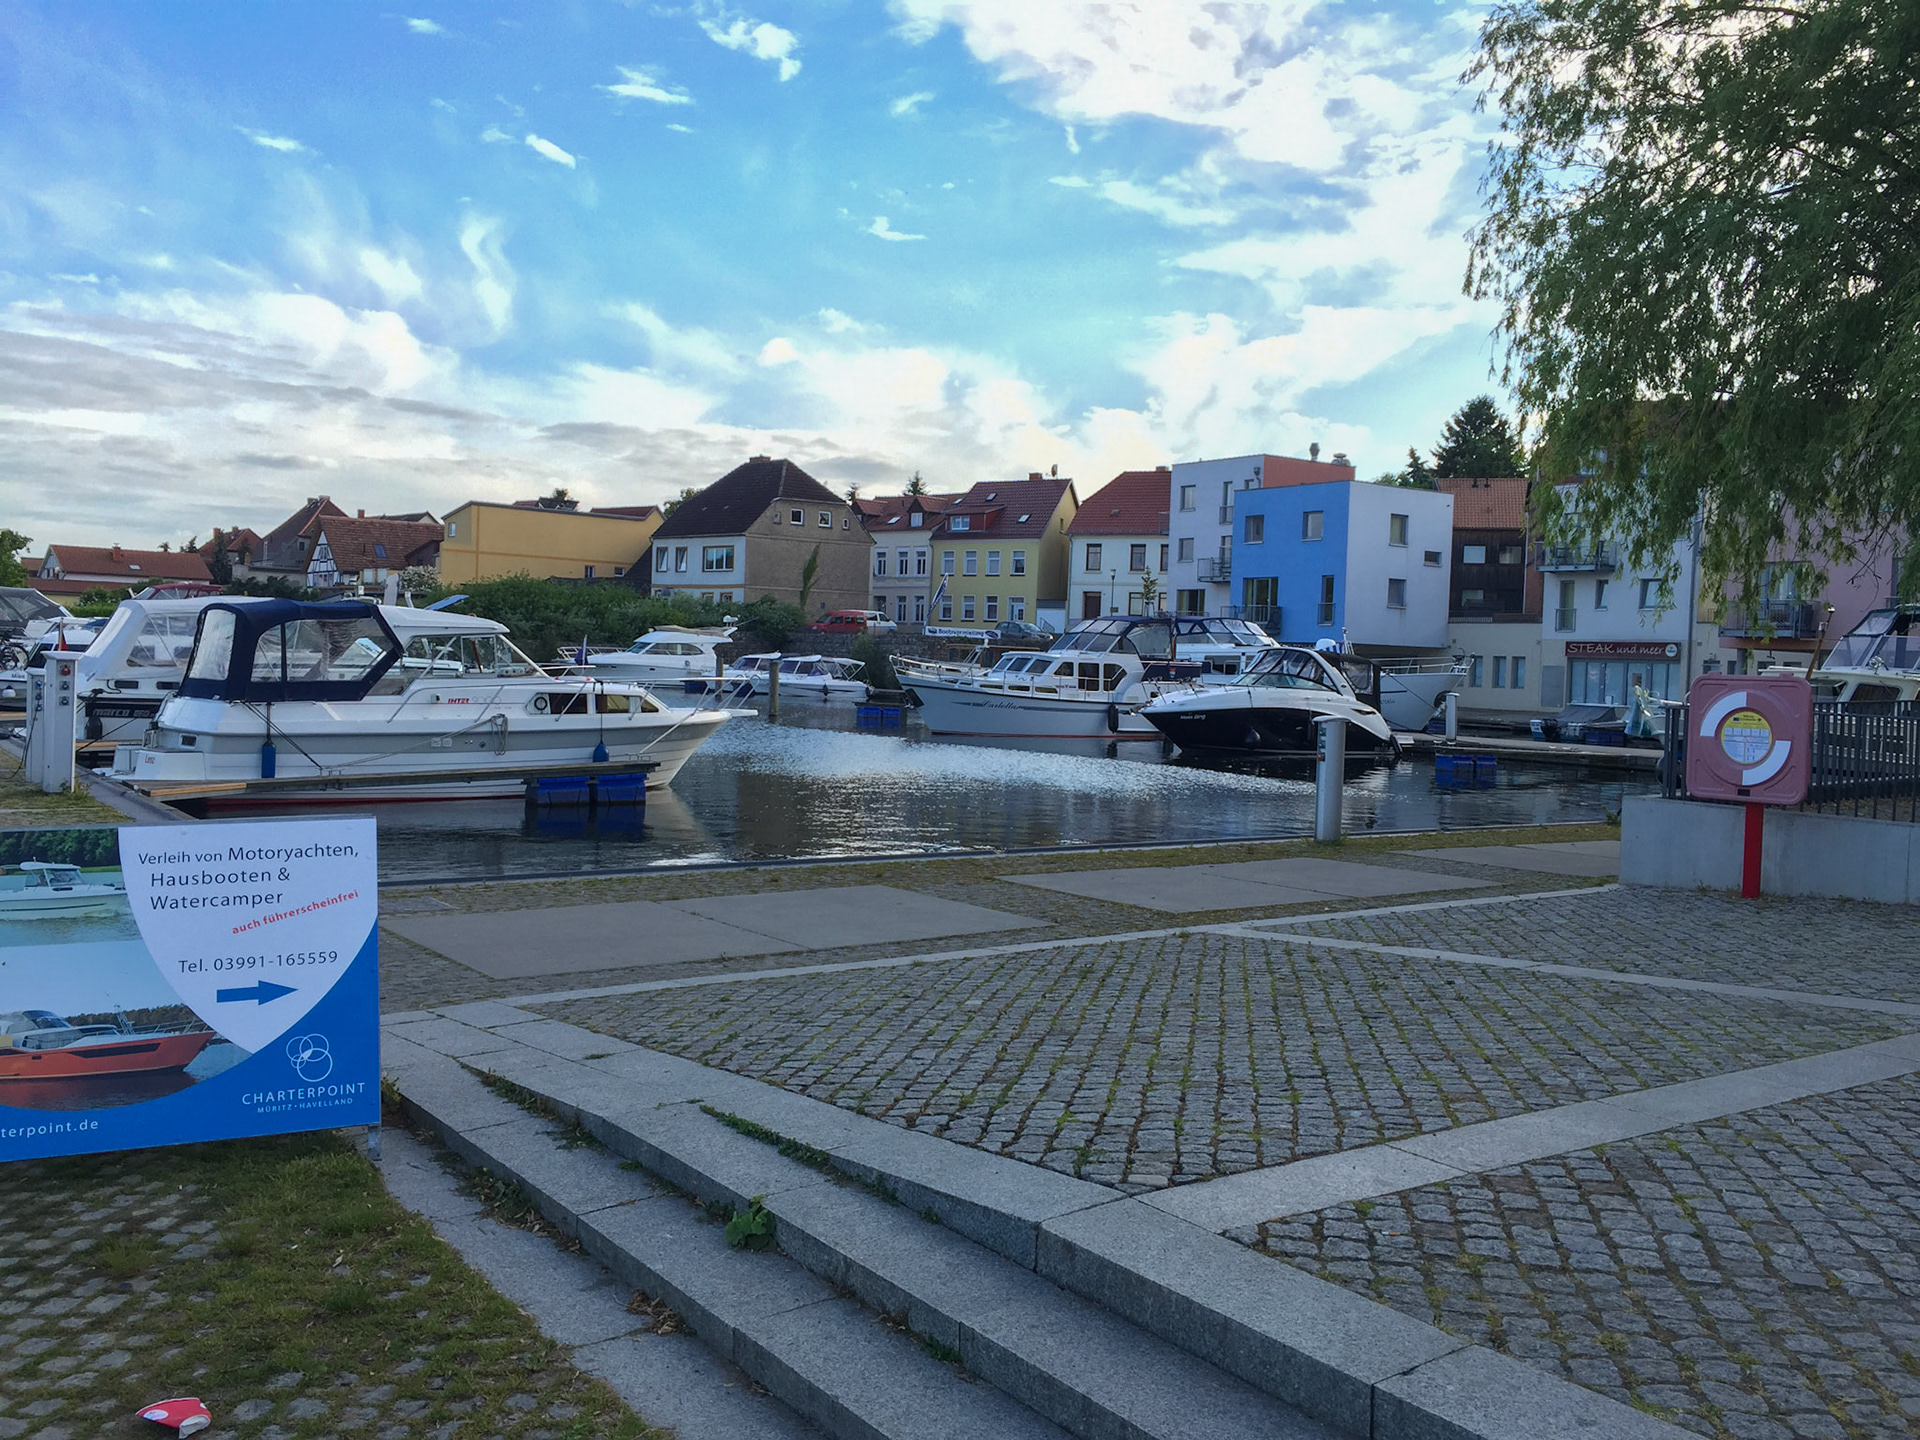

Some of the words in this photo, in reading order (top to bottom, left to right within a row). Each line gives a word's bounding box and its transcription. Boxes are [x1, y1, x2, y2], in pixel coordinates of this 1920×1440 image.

[1567, 643, 1615, 654] STEAK
[1616, 644, 1637, 654] und
[1639, 646, 1664, 655] meer
[138, 851, 191, 865] Verleih
[195, 852, 222, 863] von
[228, 843, 359, 863] Motoryachten,
[151, 870, 271, 887] Hausbooten
[277, 867, 290, 881] &
[150, 892, 283, 910] Watercamper
[232, 919, 261, 934] auch
[262, 889, 359, 925] führerscheinfrei
[178, 958, 208, 973] Tel.
[213, 950, 338, 971] 03991-165559
[242, 1082, 365, 1105] CHARTERPOINT
